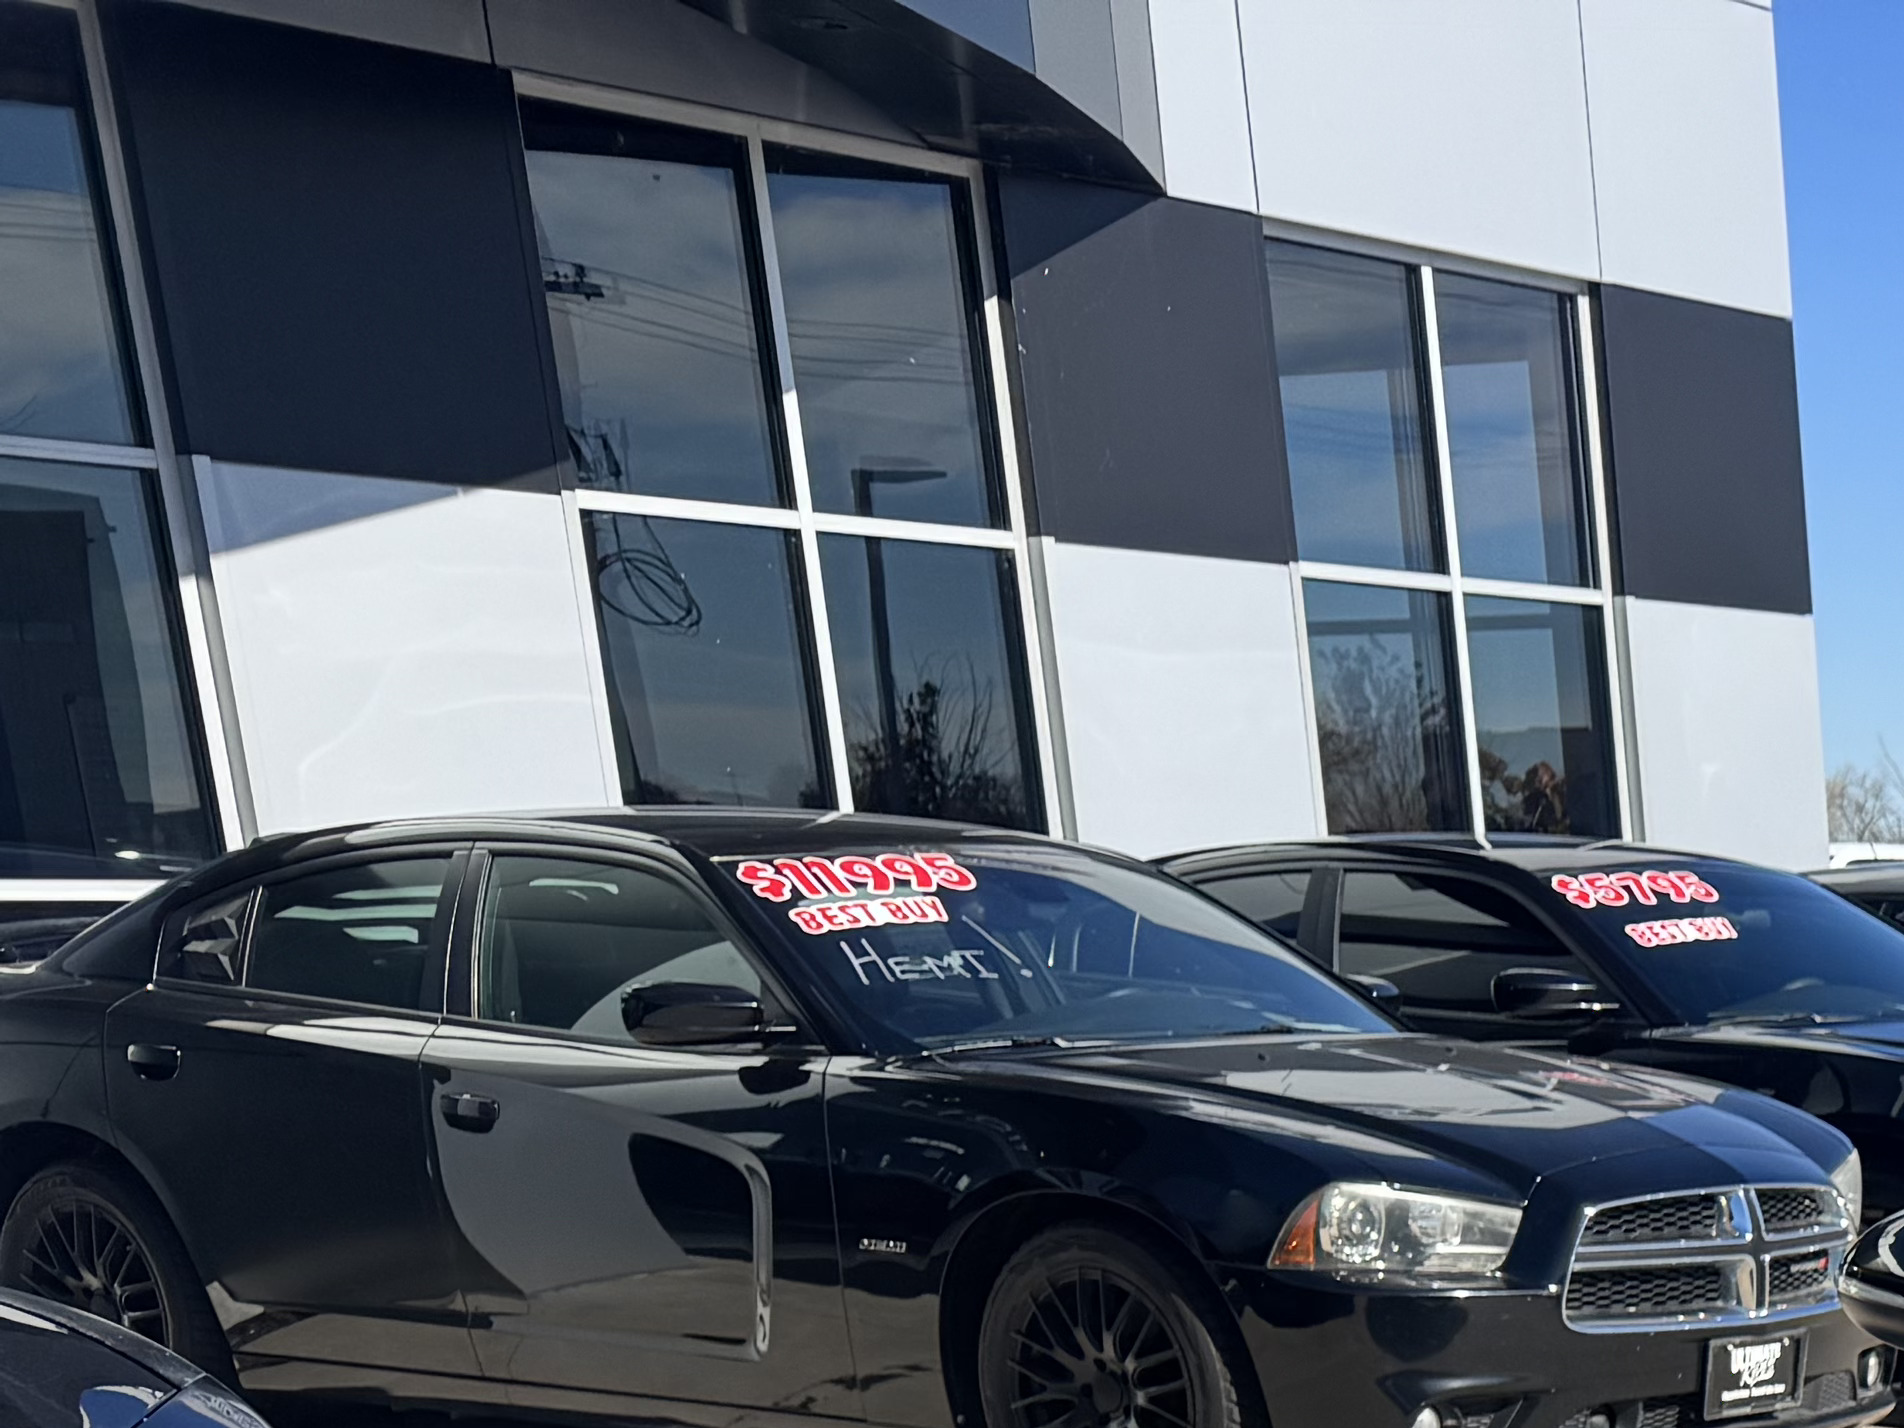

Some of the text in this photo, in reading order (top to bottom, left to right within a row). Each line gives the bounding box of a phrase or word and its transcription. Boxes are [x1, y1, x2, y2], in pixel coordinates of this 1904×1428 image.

[736, 852, 977, 902] $11995
[1551, 870, 1720, 909] $5795
[793, 897, 948, 932] BEST BUY
